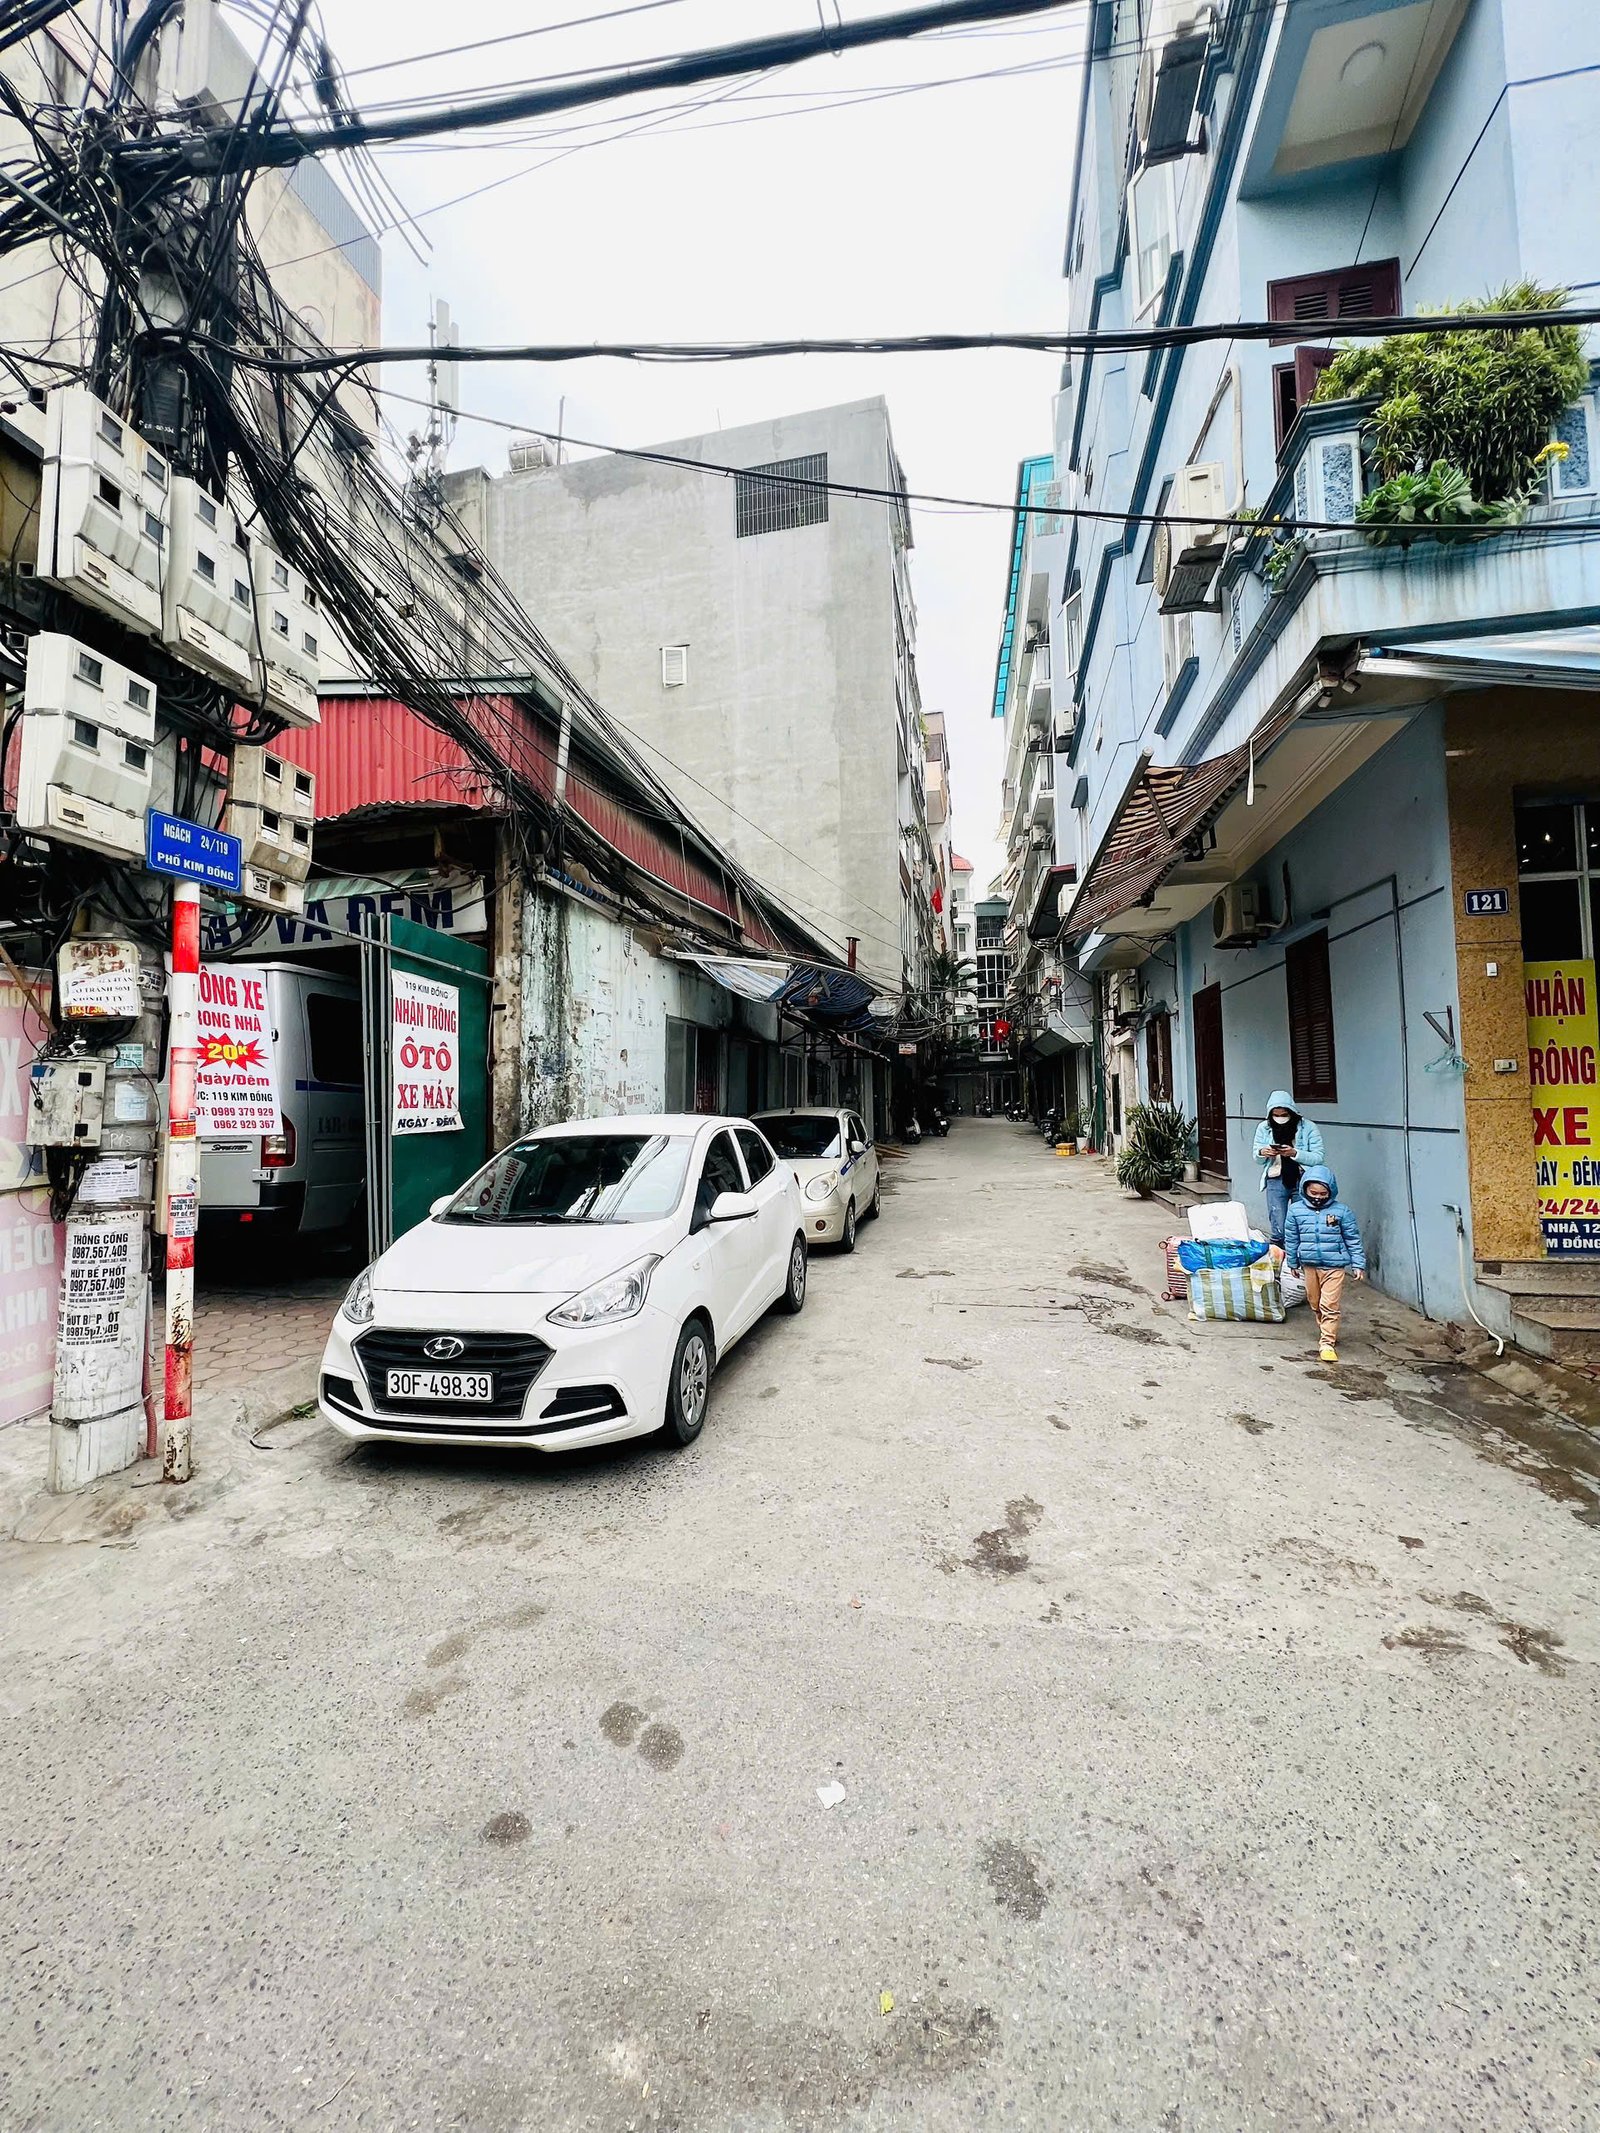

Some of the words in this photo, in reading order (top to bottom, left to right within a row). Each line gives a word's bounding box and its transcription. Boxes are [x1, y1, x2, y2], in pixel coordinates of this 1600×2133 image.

[163, 822, 191, 844] NGÁCH
[200, 835, 229, 856] 24/119
[157, 851, 181, 867] PHỐ
[183, 858, 205, 873] KIM
[1470, 893, 1502, 912] 121
[240, 978, 265, 1011] XE
[405, 980, 417, 991] 119
[417, 983, 430, 995] KIM
[234, 1013, 262, 1033] NHÀ
[394, 995, 424, 1032] NHẬN
[426, 1002, 457, 1034] TRÔNG
[400, 1035, 452, 1072] ÔTÔ
[1529, 1038, 1597, 1086] RÔNG
[211, 1091, 229, 1101] 119
[230, 1092, 248, 1102] KIM
[397, 1083, 419, 1109] XE
[422, 1079, 455, 1109] MÁY
[211, 1107, 236, 1117] 0989
[238, 1107, 255, 1117] 379
[257, 1107, 274, 1117] 929
[213, 1119, 238, 1129] 0962
[240, 1119, 257, 1129] 929
[259, 1119, 275, 1129] 367
[397, 1115, 429, 1129] NGÀY
[1532, 1106, 1592, 1146] XE
[1547, 1221, 1580, 1233] NHÀ
[71, 1244, 128, 1260] 0987.567.409
[70, 1268, 86, 1278] HÚT
[102, 1263, 127, 1277] PHỐT
[69, 1276, 126, 1293] 0987.567.409
[390, 1373, 489, 1398] 30F-498.39
